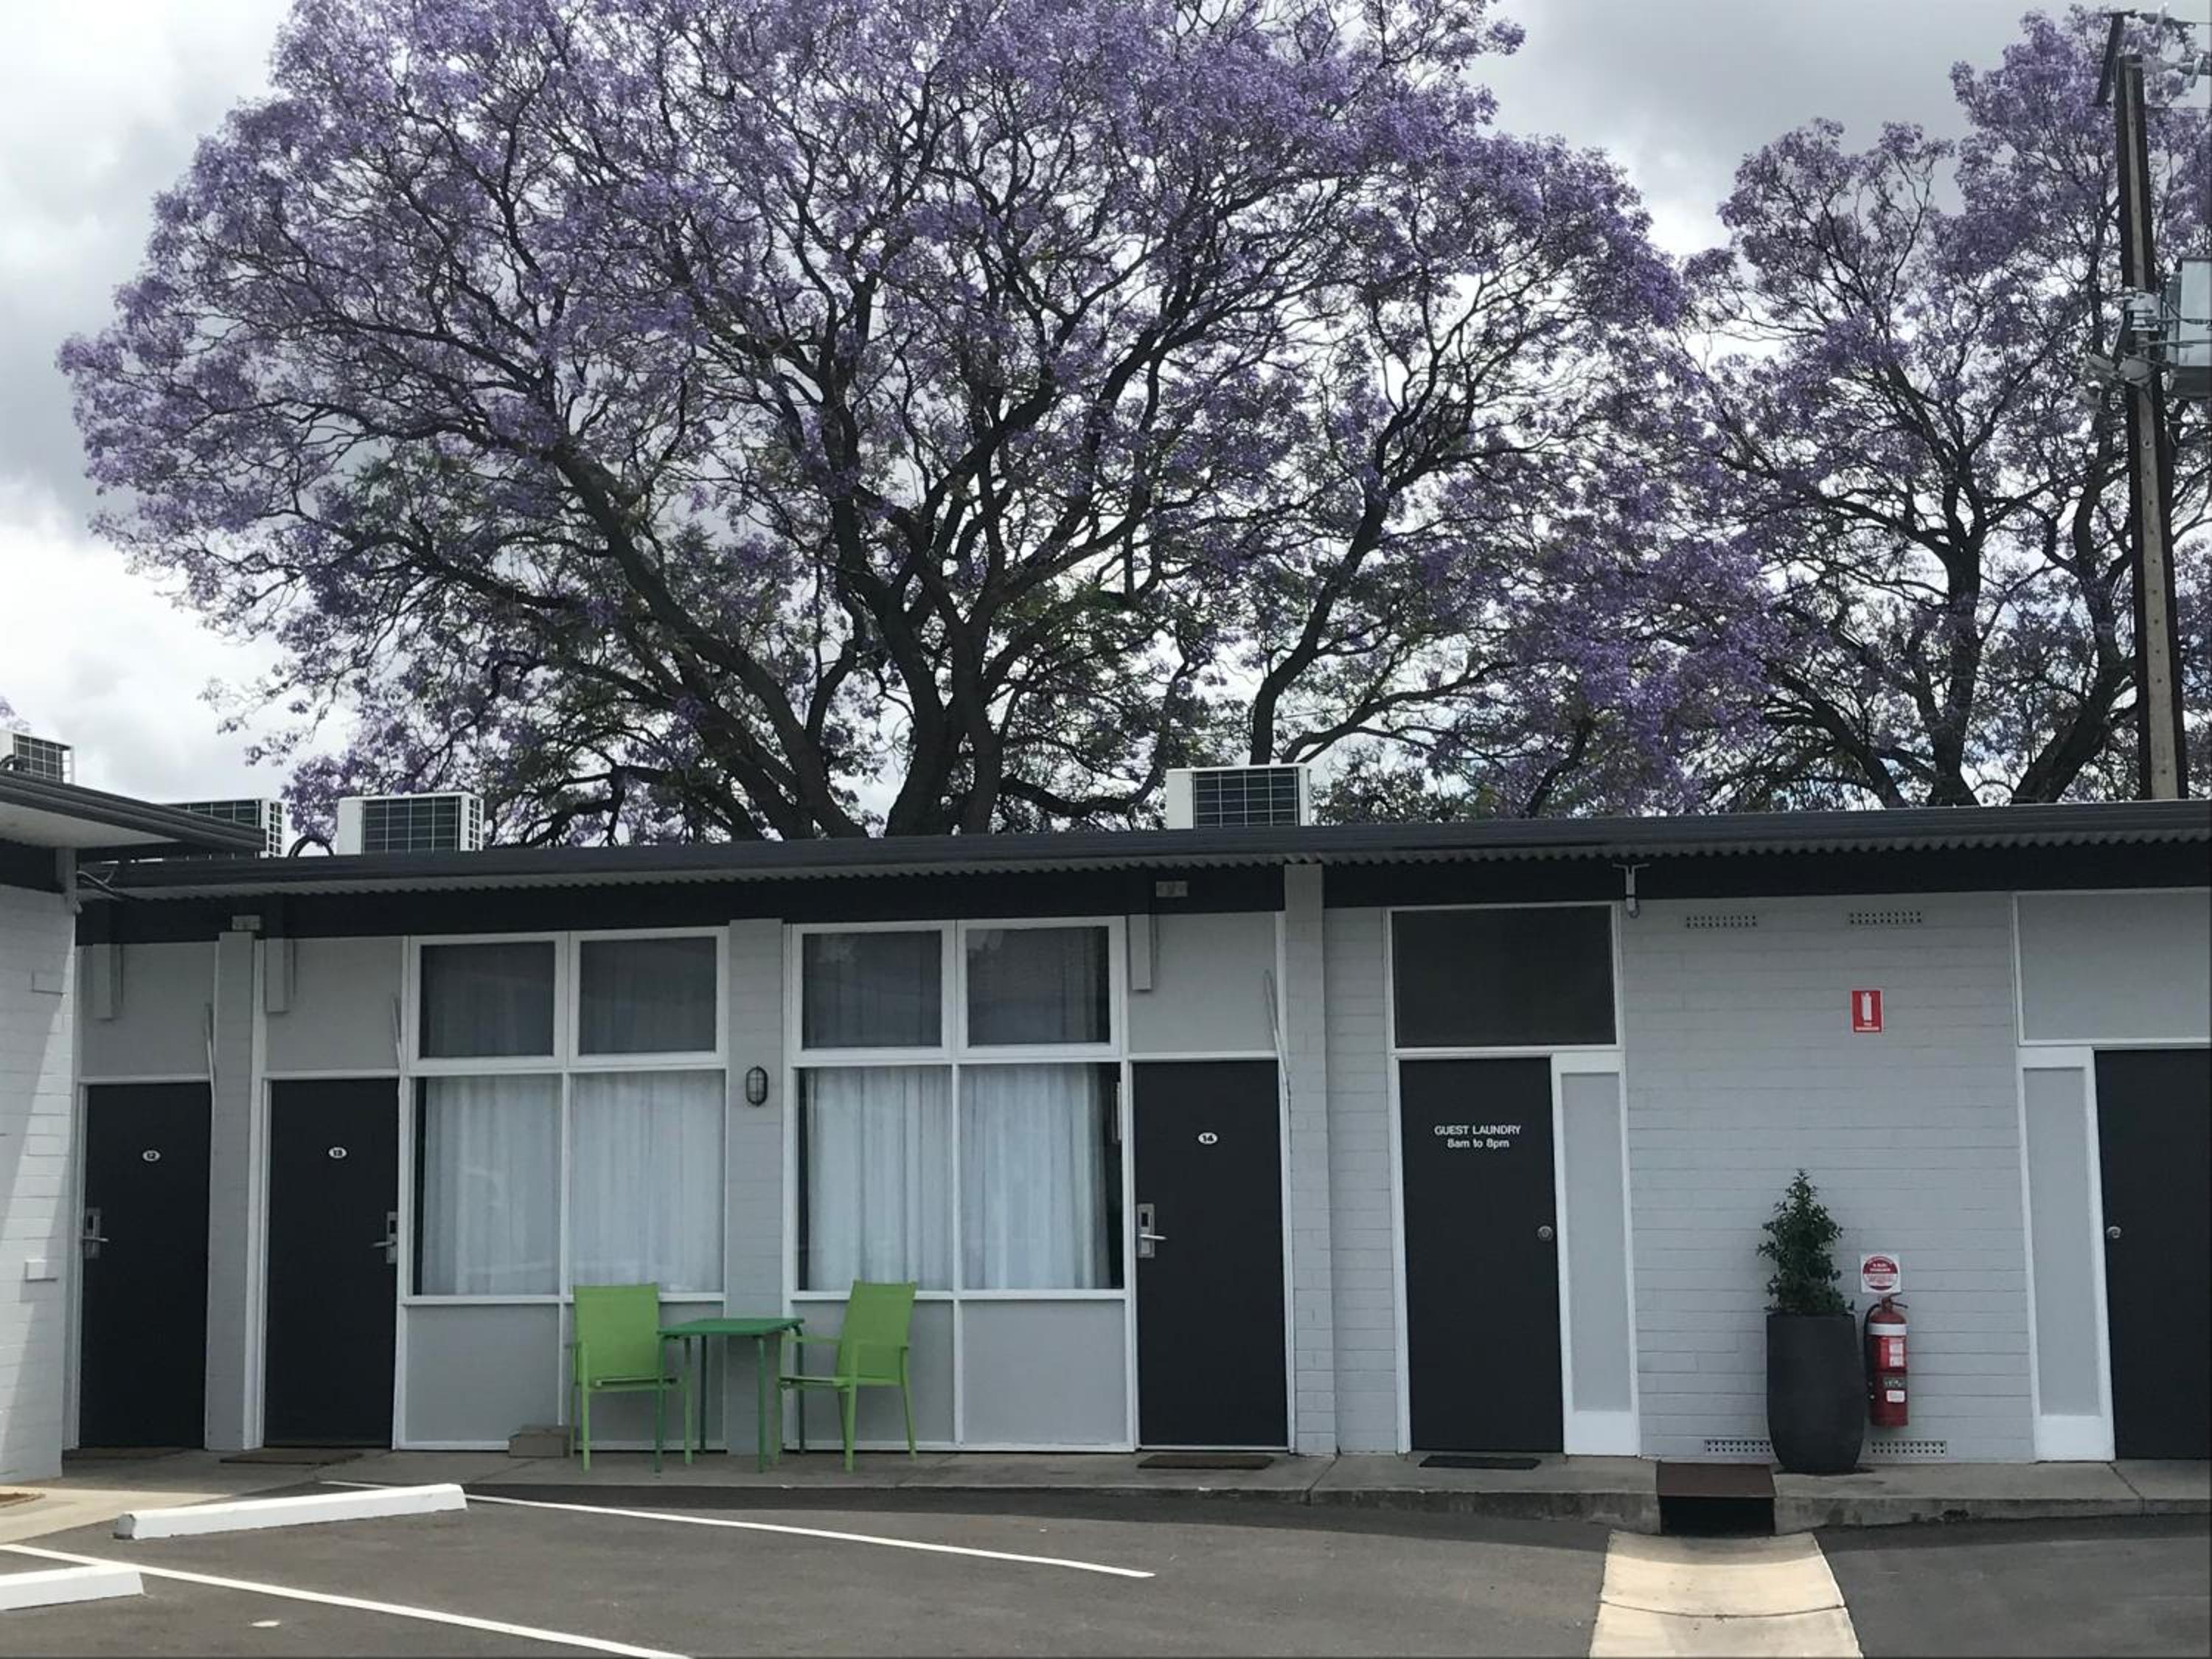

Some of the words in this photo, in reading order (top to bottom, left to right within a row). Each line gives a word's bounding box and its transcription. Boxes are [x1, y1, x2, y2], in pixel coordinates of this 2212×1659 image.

[1434, 1124, 1470, 1135] GUEST
[1472, 1124, 1521, 1135] LAUNDRY
[1447, 1138, 1470, 1148] 8am
[1472, 1138, 1484, 1148] to
[1486, 1138, 1510, 1150] 8pm
